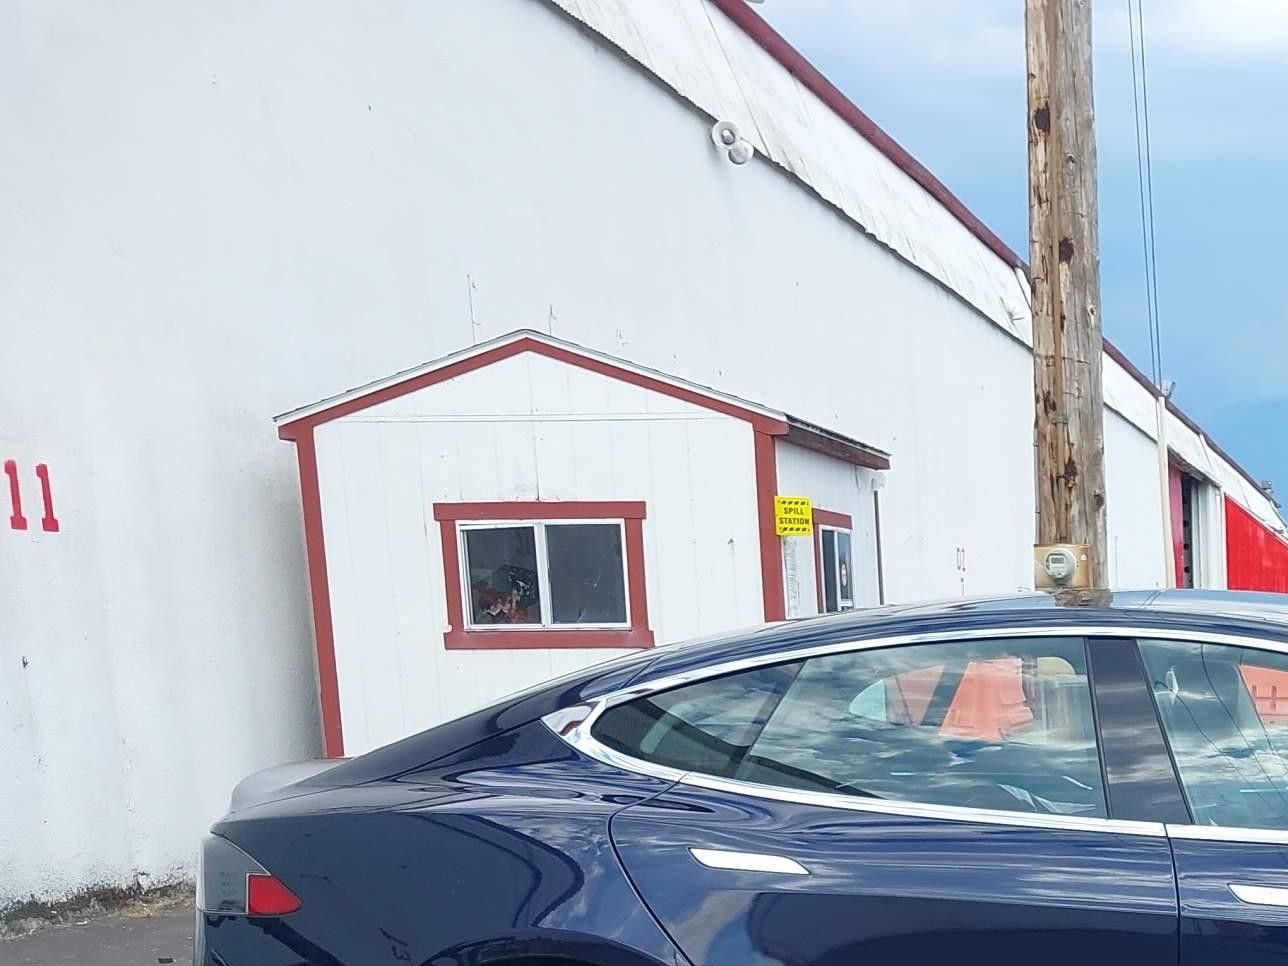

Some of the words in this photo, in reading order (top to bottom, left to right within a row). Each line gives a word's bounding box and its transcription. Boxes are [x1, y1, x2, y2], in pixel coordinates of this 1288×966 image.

[4, 459, 60, 532] 11
[783, 507, 804, 515] SPILL
[779, 517, 810, 525] STATION
